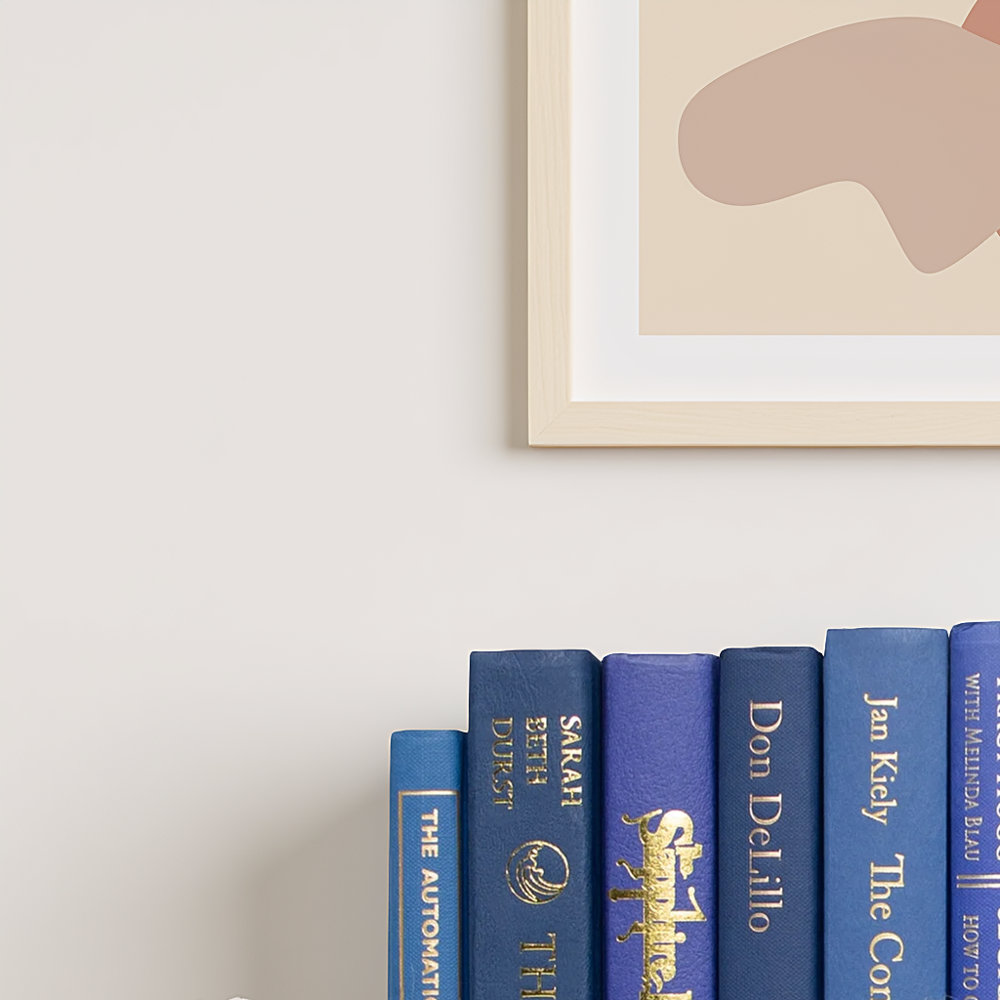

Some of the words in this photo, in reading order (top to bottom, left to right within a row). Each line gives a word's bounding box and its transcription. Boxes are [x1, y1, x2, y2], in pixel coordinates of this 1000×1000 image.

[864, 693, 899, 742] Jan
[964, 673, 981, 722] WITH
[492, 716, 514, 810] DURST
[525, 716, 548, 786] BETH
[559, 714, 583, 807] SARAH
[749, 700, 783, 779] Don
[964, 727, 983, 811] MELINDA
[862, 751, 898, 826] Kiely
[421, 809, 438, 858] THE
[748, 793, 783, 933] DeLillo
[964, 817, 983, 861] BLAU
[869, 853, 905, 920] The
[963, 914, 980, 958] HOW
[963, 968, 980, 990] TO
